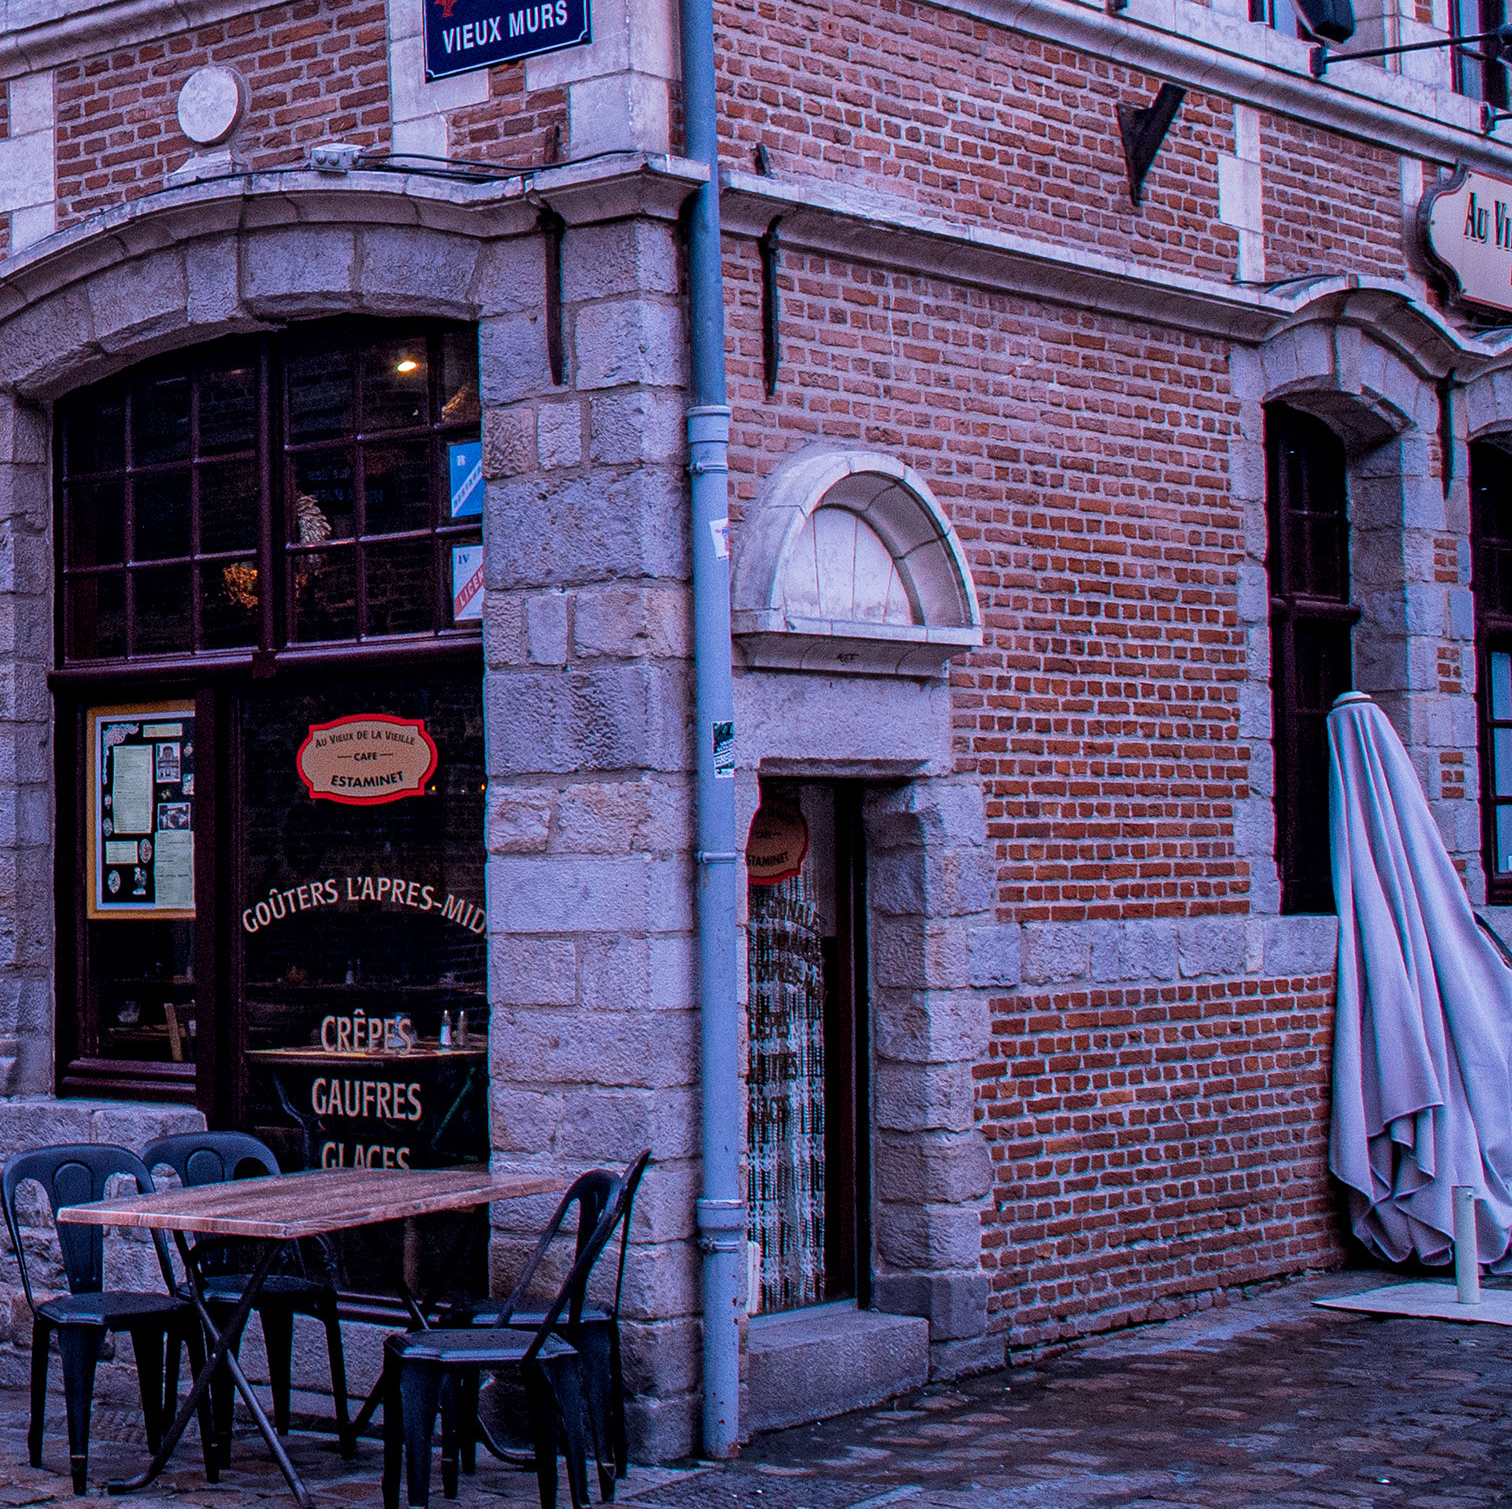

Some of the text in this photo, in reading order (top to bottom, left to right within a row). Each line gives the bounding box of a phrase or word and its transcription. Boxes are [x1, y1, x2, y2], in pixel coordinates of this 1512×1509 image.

[442, 0, 568, 54] VIEUX MURS
[353, 752, 378, 761] CAFE
[356, 730, 368, 740] DE
[371, 730, 382, 740] LA
[330, 770, 404, 788] ESTAMINET
[242, 876, 488, 938] GOÛTERS L'APRES-MID
[321, 1008, 412, 1055] CRÊPES
[312, 1077, 423, 1121] GAUFRES
